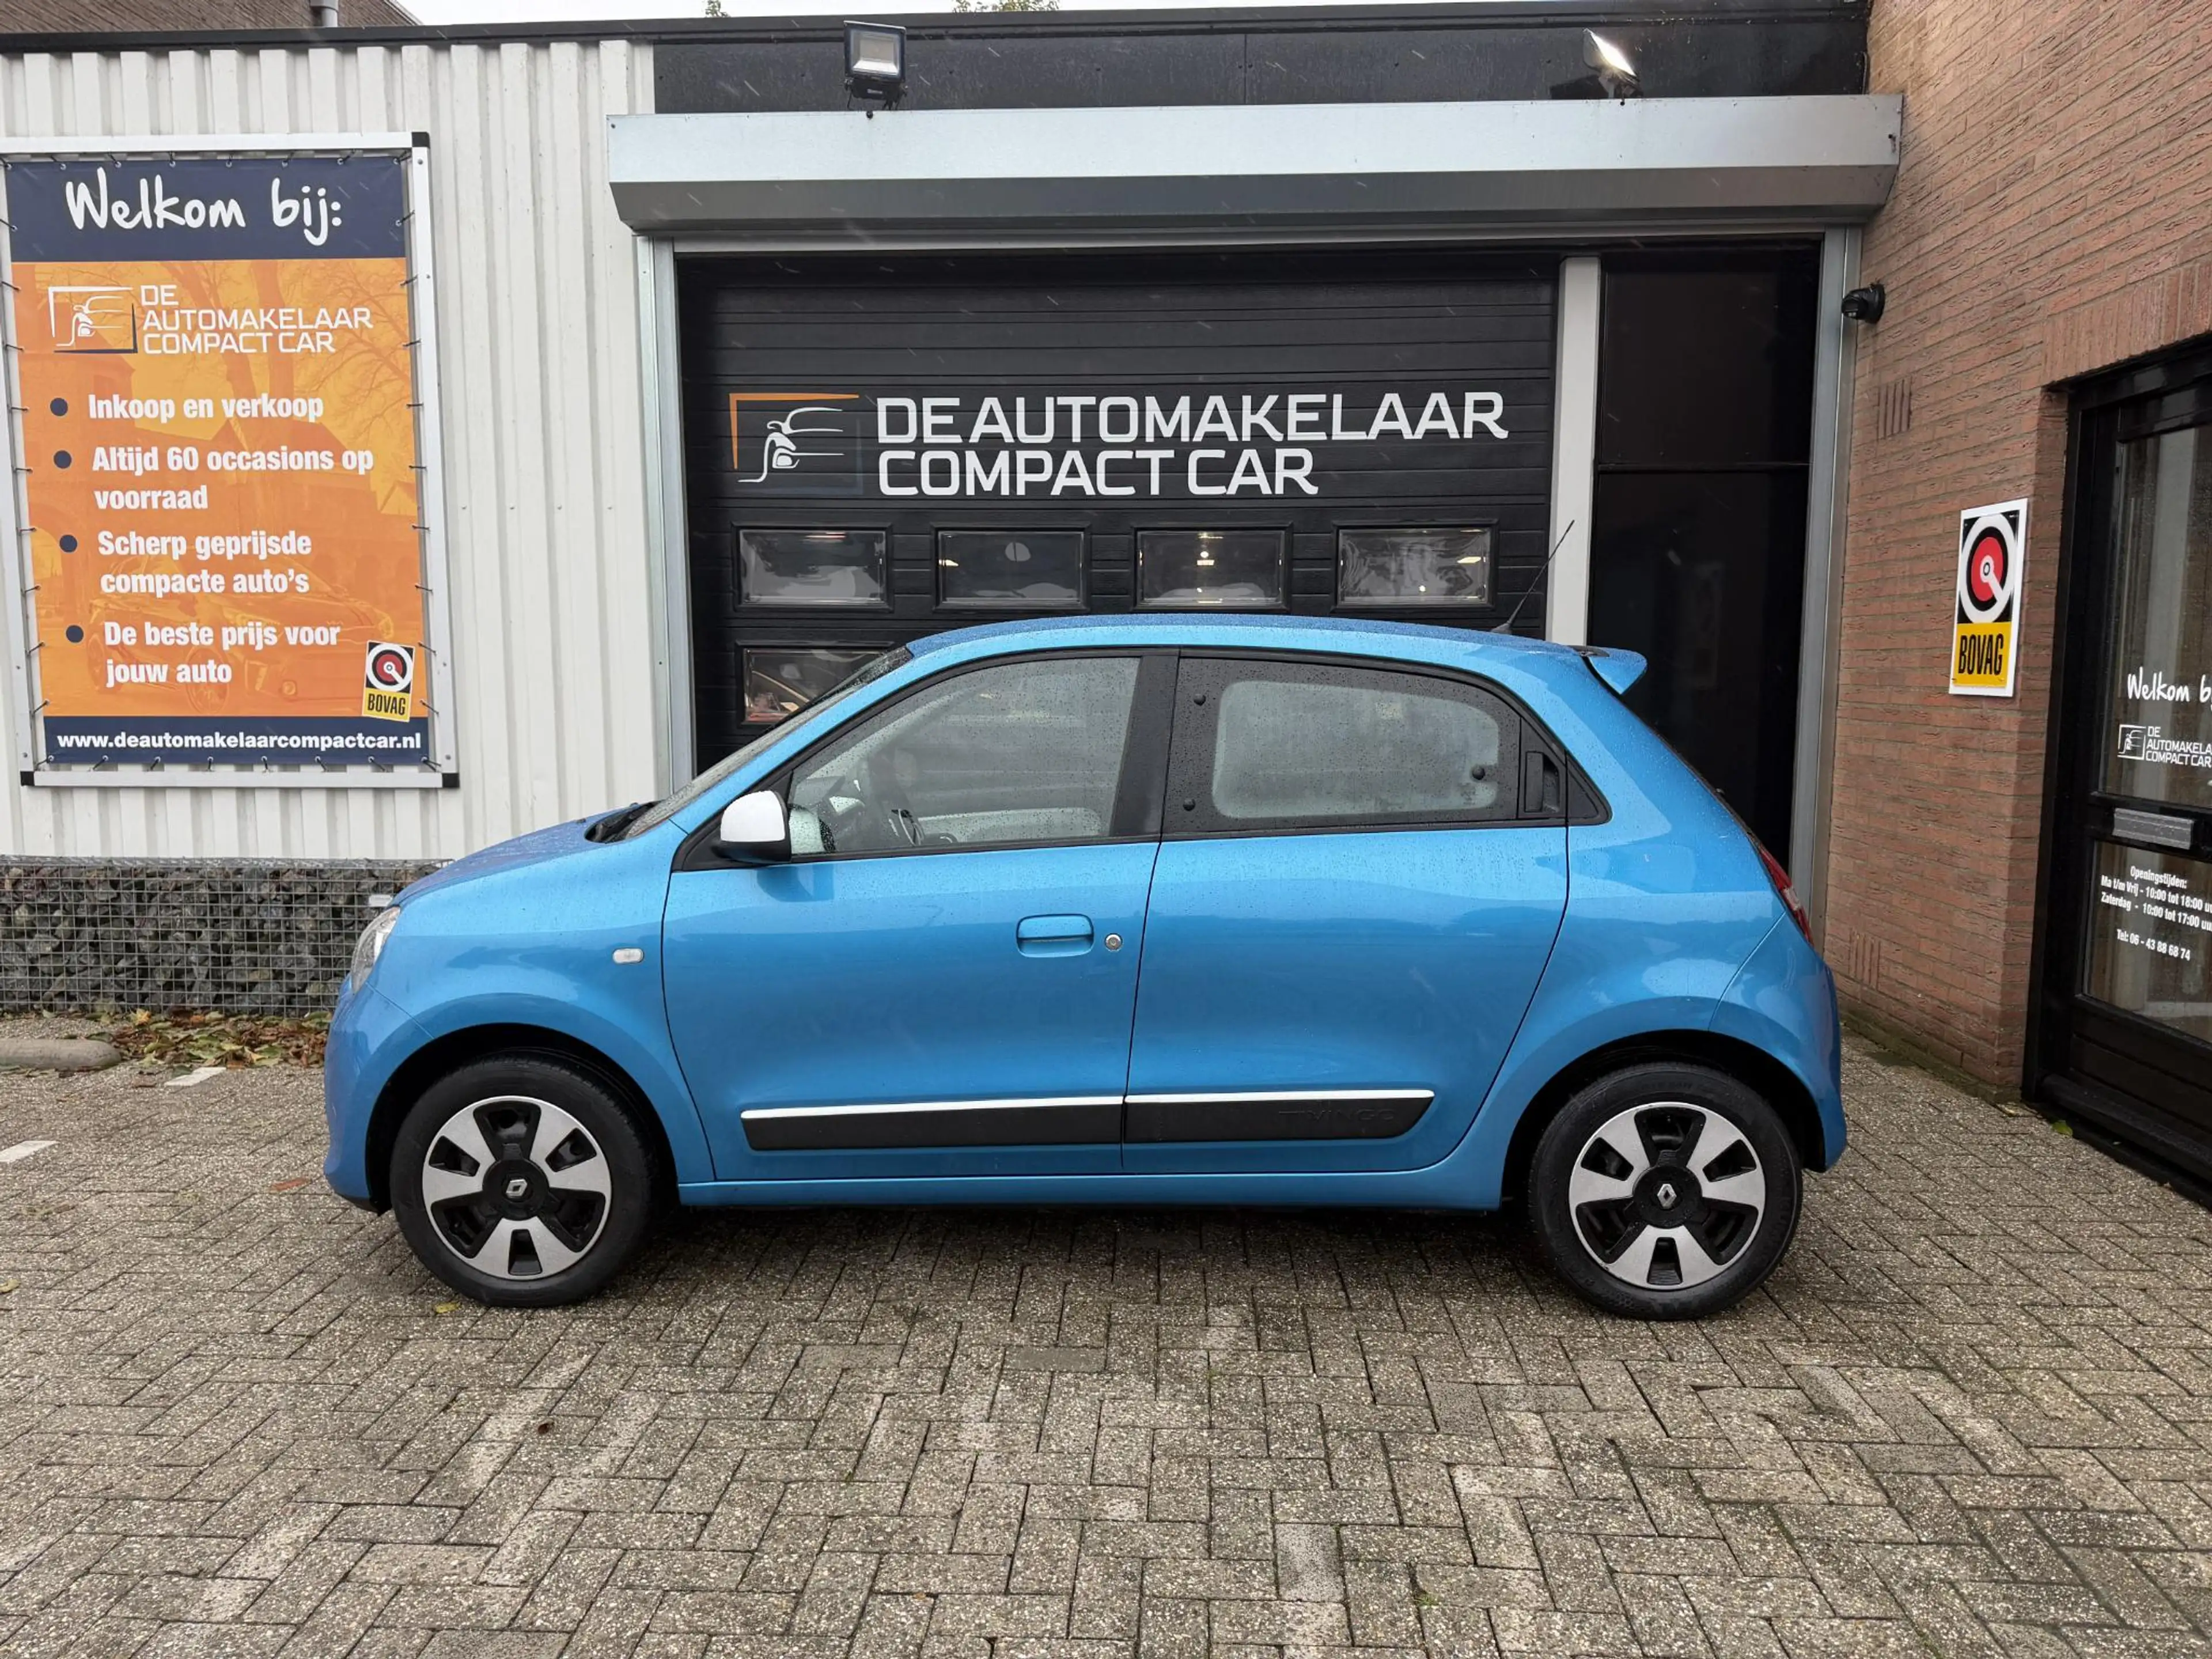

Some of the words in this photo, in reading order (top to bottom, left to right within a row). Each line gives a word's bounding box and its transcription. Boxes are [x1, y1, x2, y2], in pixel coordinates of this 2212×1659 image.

[66, 167, 245, 229] Welkom
[271, 177, 342, 246] bij:
[141, 285, 179, 306] DE
[143, 308, 374, 331] AUTOMAKELAAR
[143, 332, 272, 354] COMPACT
[278, 332, 336, 353] CAR
[88, 393, 175, 423] Inkoop
[184, 399, 214, 418] en
[222, 393, 324, 422] verkoop
[877, 397, 963, 444] DE
[969, 392, 1509, 444] AUTOMAKELAAR
[92, 447, 159, 476] Altijd
[167, 447, 199, 471] 60
[207, 446, 334, 471] occasions
[342, 449, 374, 475] op
[879, 449, 1174, 495] COMPACT
[1188, 448, 1319, 495] CAR
[94, 485, 208, 510] voorraad
[99, 531, 187, 560] Scherp
[195, 530, 312, 561] geprijsde
[100, 569, 225, 598] compacte
[233, 570, 309, 593] auto's
[104, 622, 137, 646] De
[145, 622, 214, 646] beste
[222, 621, 278, 651] prijs
[285, 624, 340, 646] voor
[1958, 634, 2004, 676] BOVAG
[106, 660, 168, 688] jouw
[176, 661, 232, 684] auto
[2127, 666, 2190, 702] Welkom
[368, 693, 406, 716] BOVAG
[57, 732, 421, 752] www.deautomakelaarcompactcar.nl
[2147, 726, 2161, 737] DE
[2146, 751, 2190, 766] COMPACT
[2191, 755, 2212, 768] CAR
[2130, 866, 2187, 889] Openingstijden:
[2101, 875, 2112, 888] Ma
[2113, 878, 2126, 892] t/m
[2146, 886, 2166, 902] 10:00
[2168, 892, 2179, 905] tot
[2181, 895, 2203, 911] 18:00
[2101, 892, 2131, 911] Zaterdag
[2143, 903, 2163, 918] 10:00
[2165, 908, 2176, 922] tot
[2177, 912, 2200, 927] 17:00
[2117, 929, 2129, 942] Tel:
[2130, 933, 2139, 945] 06
[2146, 938, 2156, 950] 43
[2157, 940, 2167, 954] 88
[2168, 944, 2179, 958] 68
[2180, 948, 2190, 961] 74
